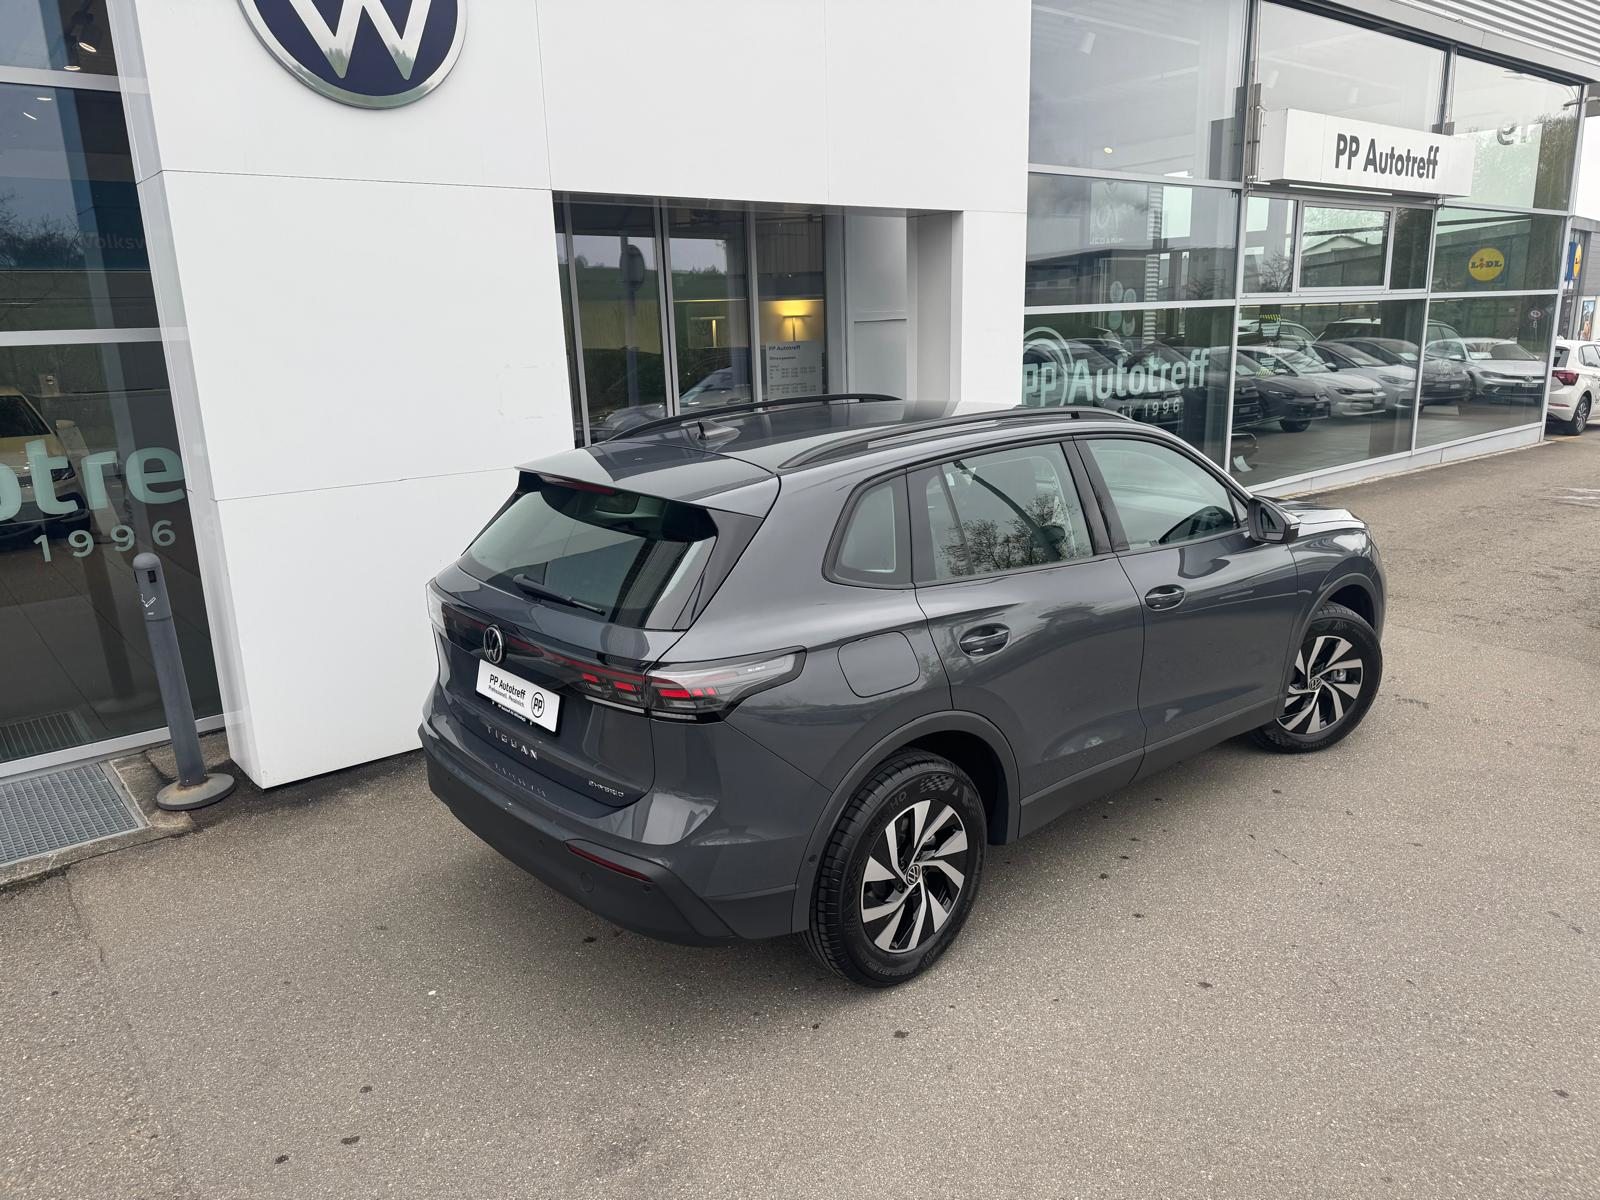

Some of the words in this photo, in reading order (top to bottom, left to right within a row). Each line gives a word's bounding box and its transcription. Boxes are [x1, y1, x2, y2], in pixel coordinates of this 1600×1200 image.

[1335, 133, 1360, 170] PP
[1363, 138, 1440, 179] Autotreff
[1067, 348, 1210, 404] Autotreff
[1143, 399, 1181, 417] 1996
[33, 520, 177, 562] 1996
[490, 673, 499, 686] PP
[499, 679, 526, 699] Autotreff
[533, 697, 543, 711] PP
[486, 724, 538, 760] TIGUAN
